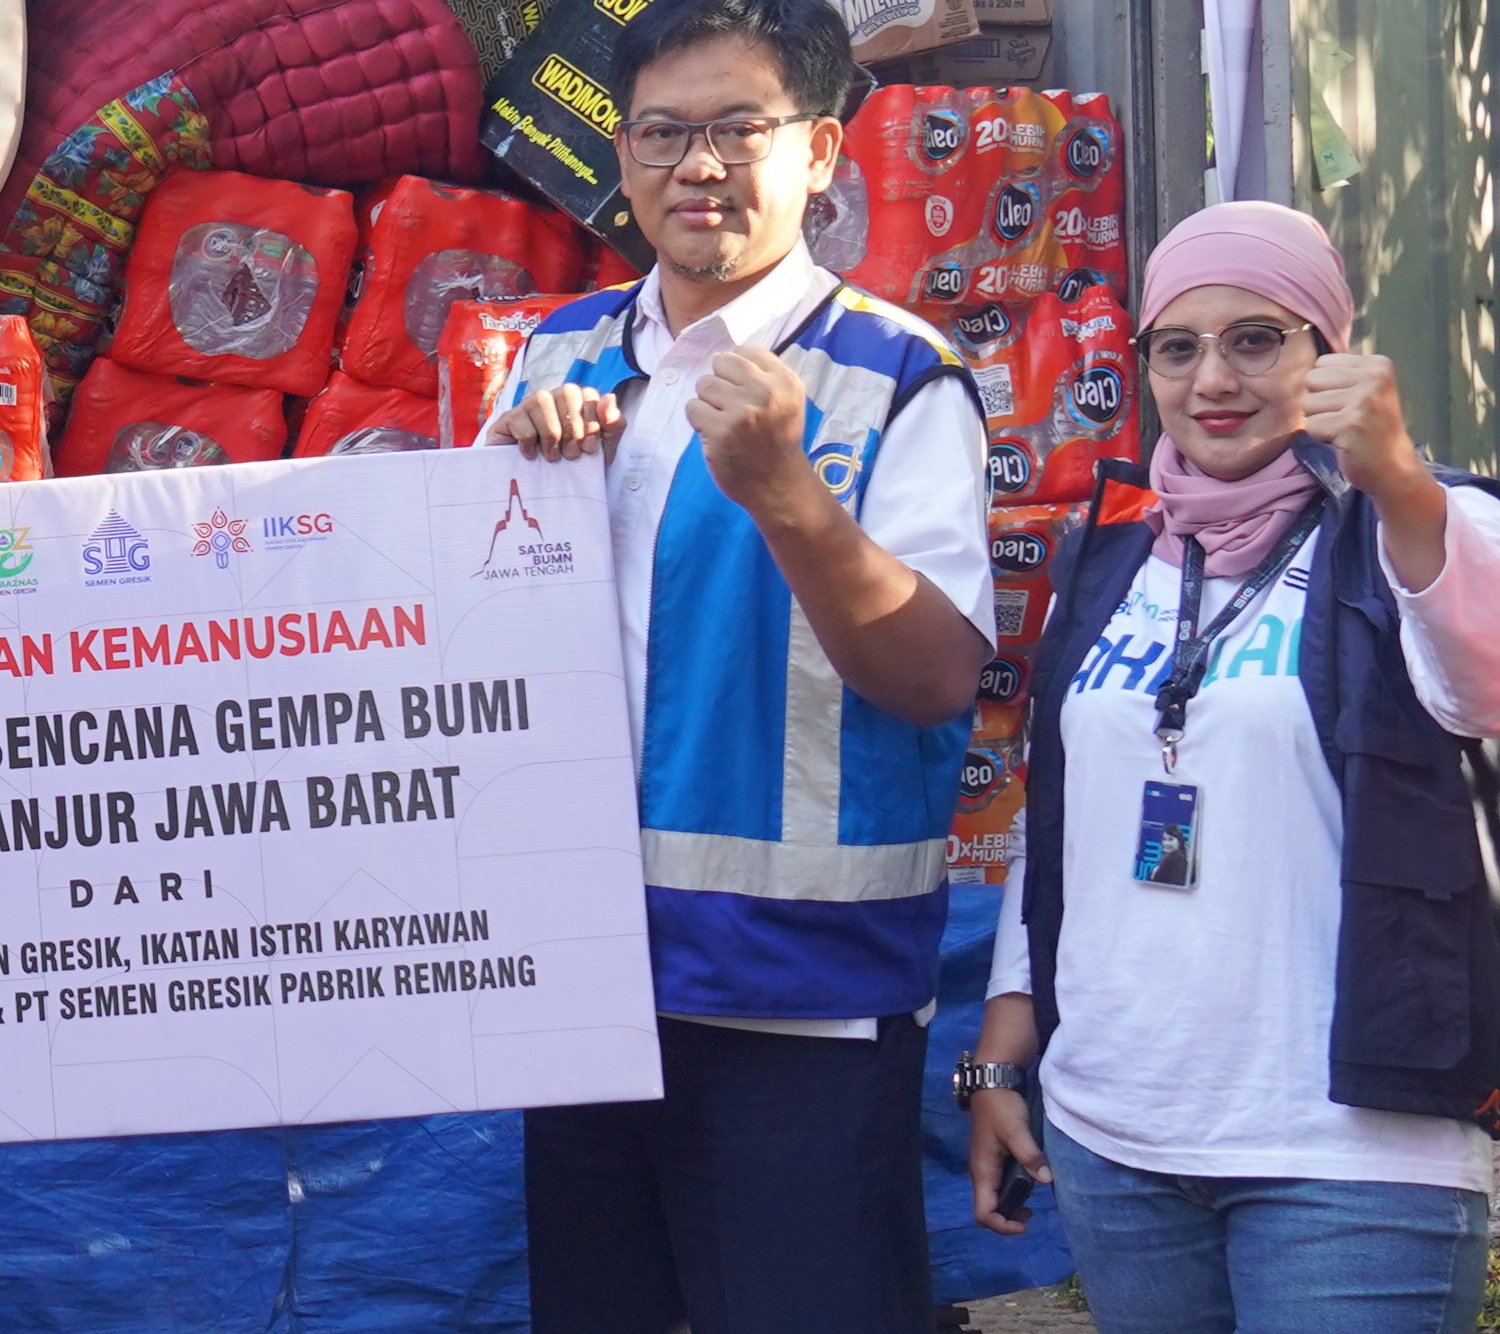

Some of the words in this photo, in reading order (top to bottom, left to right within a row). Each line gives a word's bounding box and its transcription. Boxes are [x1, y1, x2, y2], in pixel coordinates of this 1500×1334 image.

[491, 97, 521, 125] Makin
[519, 115, 552, 149] Banyak
[1072, 141, 1099, 165] Cleo
[999, 196, 1031, 227] Cleo
[480, 314, 541, 331] Tanobel
[957, 309, 1005, 333] Cleo
[1074, 376, 1118, 410] Cleo
[989, 455, 1024, 483] Cle
[263, 513, 333, 538] IIKSG
[518, 541, 572, 555] SATGAS
[533, 553, 573, 566] BUMN
[992, 539, 1040, 564] Cleo
[85, 578, 117, 588] SEMEN
[119, 575, 152, 585] GRESIK
[483, 568, 520, 581] JAWA
[523, 564, 574, 577] TENGAH
[1233, 586, 1256, 610] SIG
[70, 604, 427, 673] KEMANUSIAAN
[980, 671, 1014, 696] Cle
[216, 690, 385, 753] GEMPA
[401, 678, 529, 739] BUMI
[962, 765, 993, 787] leo
[155, 779, 290, 841] JAWA
[306, 766, 460, 828] BARAT
[945, 834, 971, 864] 0x
[972, 832, 1011, 849] LEBI
[971, 847, 1007, 863] MUR
[20, 936, 131, 973] GRESIK,
[141, 928, 240, 966] IKATAN
[250, 921, 322, 957] ISTRI
[333, 909, 490, 951] KARYAWAN
[15, 990, 49, 1023] PT
[59, 982, 157, 1020] SEMEN
[168, 974, 271, 1012] GRESIK
[280, 966, 385, 1004] PABRIK
[394, 954, 536, 995] REMBANG
